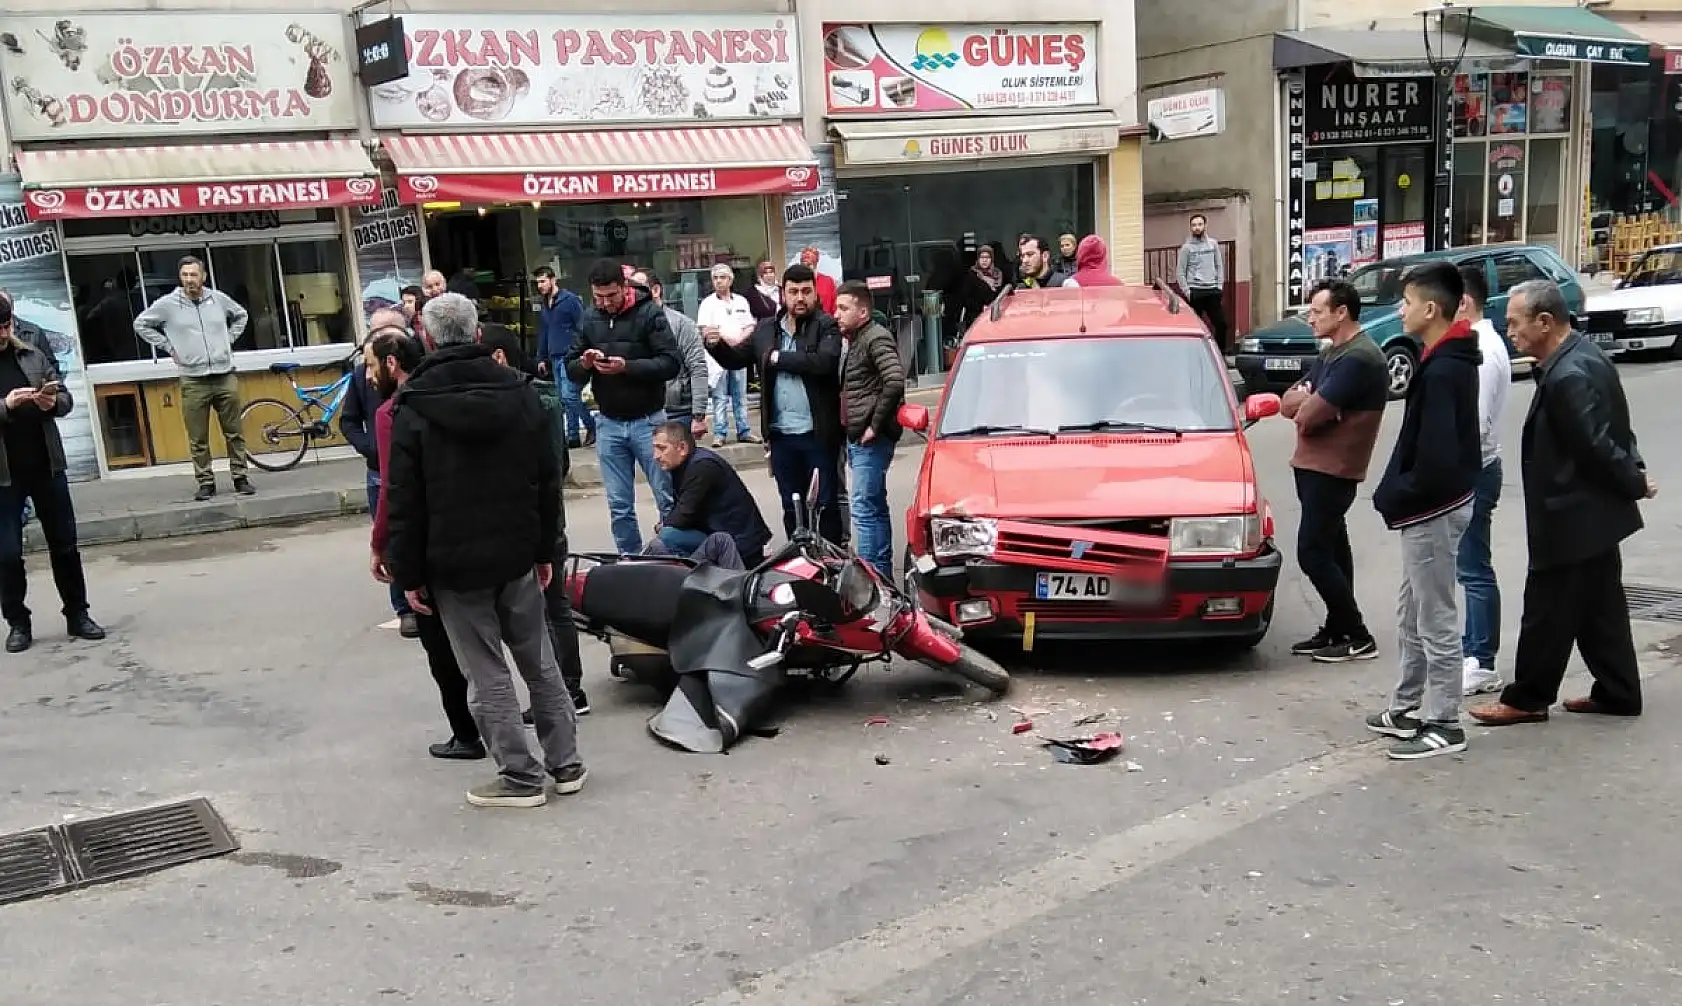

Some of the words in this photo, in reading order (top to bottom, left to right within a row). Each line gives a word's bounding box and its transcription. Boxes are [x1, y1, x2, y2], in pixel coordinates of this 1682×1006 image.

[112, 38, 256, 76] ÖZKAN
[404, 28, 541, 67] ZKAN
[552, 19, 789, 66] PASTANESİ
[962, 28, 1086, 72] GÜNEŞ
[1001, 76, 1029, 88] OLUK
[1322, 82, 1419, 109] NURER
[68, 90, 311, 123] DONDURMA
[1335, 108, 1406, 129] İNŞAAT
[930, 137, 984, 156] GÜNEŞ
[989, 134, 1029, 152] OLUK
[86, 187, 181, 212] ÖZKAN
[197, 179, 329, 206] PASTANESİ
[523, 173, 599, 195] ÖZKAN
[612, 169, 716, 193] PASTANESİ
[785, 191, 835, 223] pastanesi
[0, 227, 57, 262] stanesi
[354, 211, 417, 249] pastanesi
[1051, 576, 1078, 595] 74
[1084, 576, 1110, 596] AD
